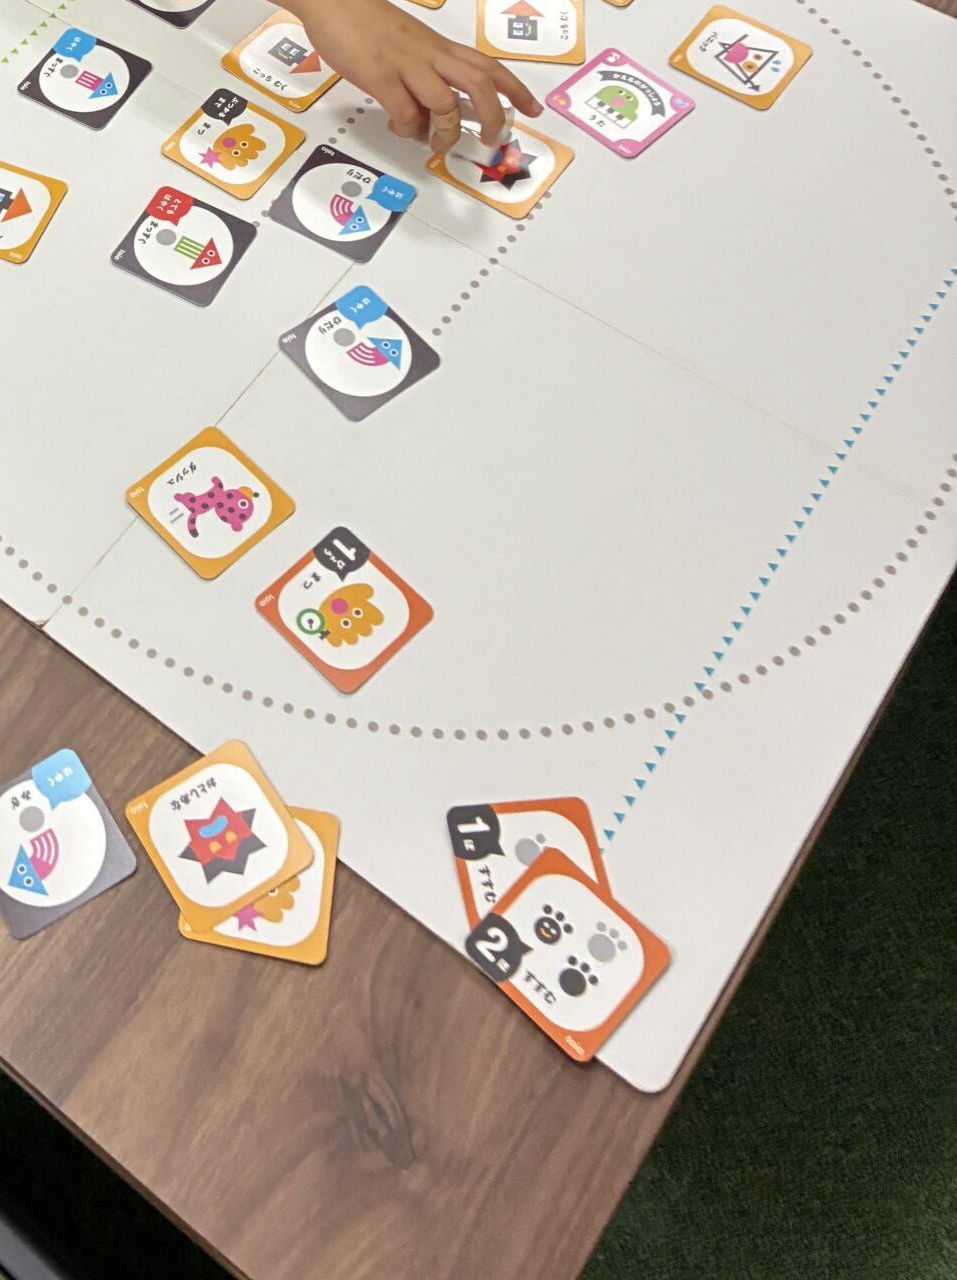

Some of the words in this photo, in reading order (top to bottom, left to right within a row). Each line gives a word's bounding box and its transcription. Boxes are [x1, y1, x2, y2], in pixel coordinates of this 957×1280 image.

[43, 57, 64, 78] まっすぐ
[253, 68, 273, 82] こっち
[274, 80, 288, 91] むく
[197, 122, 211, 135] まつ
[588, 114, 606, 128] うた
[346, 169, 372, 184] ひだり
[156, 193, 172, 211] はやく
[382, 186, 404, 199] はやく
[166, 198, 182, 215] とても
[138, 221, 159, 244] まっすぐ
[350, 297, 371, 313] はやく
[318, 316, 342, 334] ひだり
[167, 461, 197, 486] ダッシュ
[332, 538, 357, 561] 1
[303, 572, 322, 590] まつ
[47, 766, 73, 787] はやく
[10, 789, 31, 810] みぎ
[169, 776, 218, 811] おとしあな
[477, 865, 496, 904] すすむ
[523, 970, 558, 1005] すすむ
